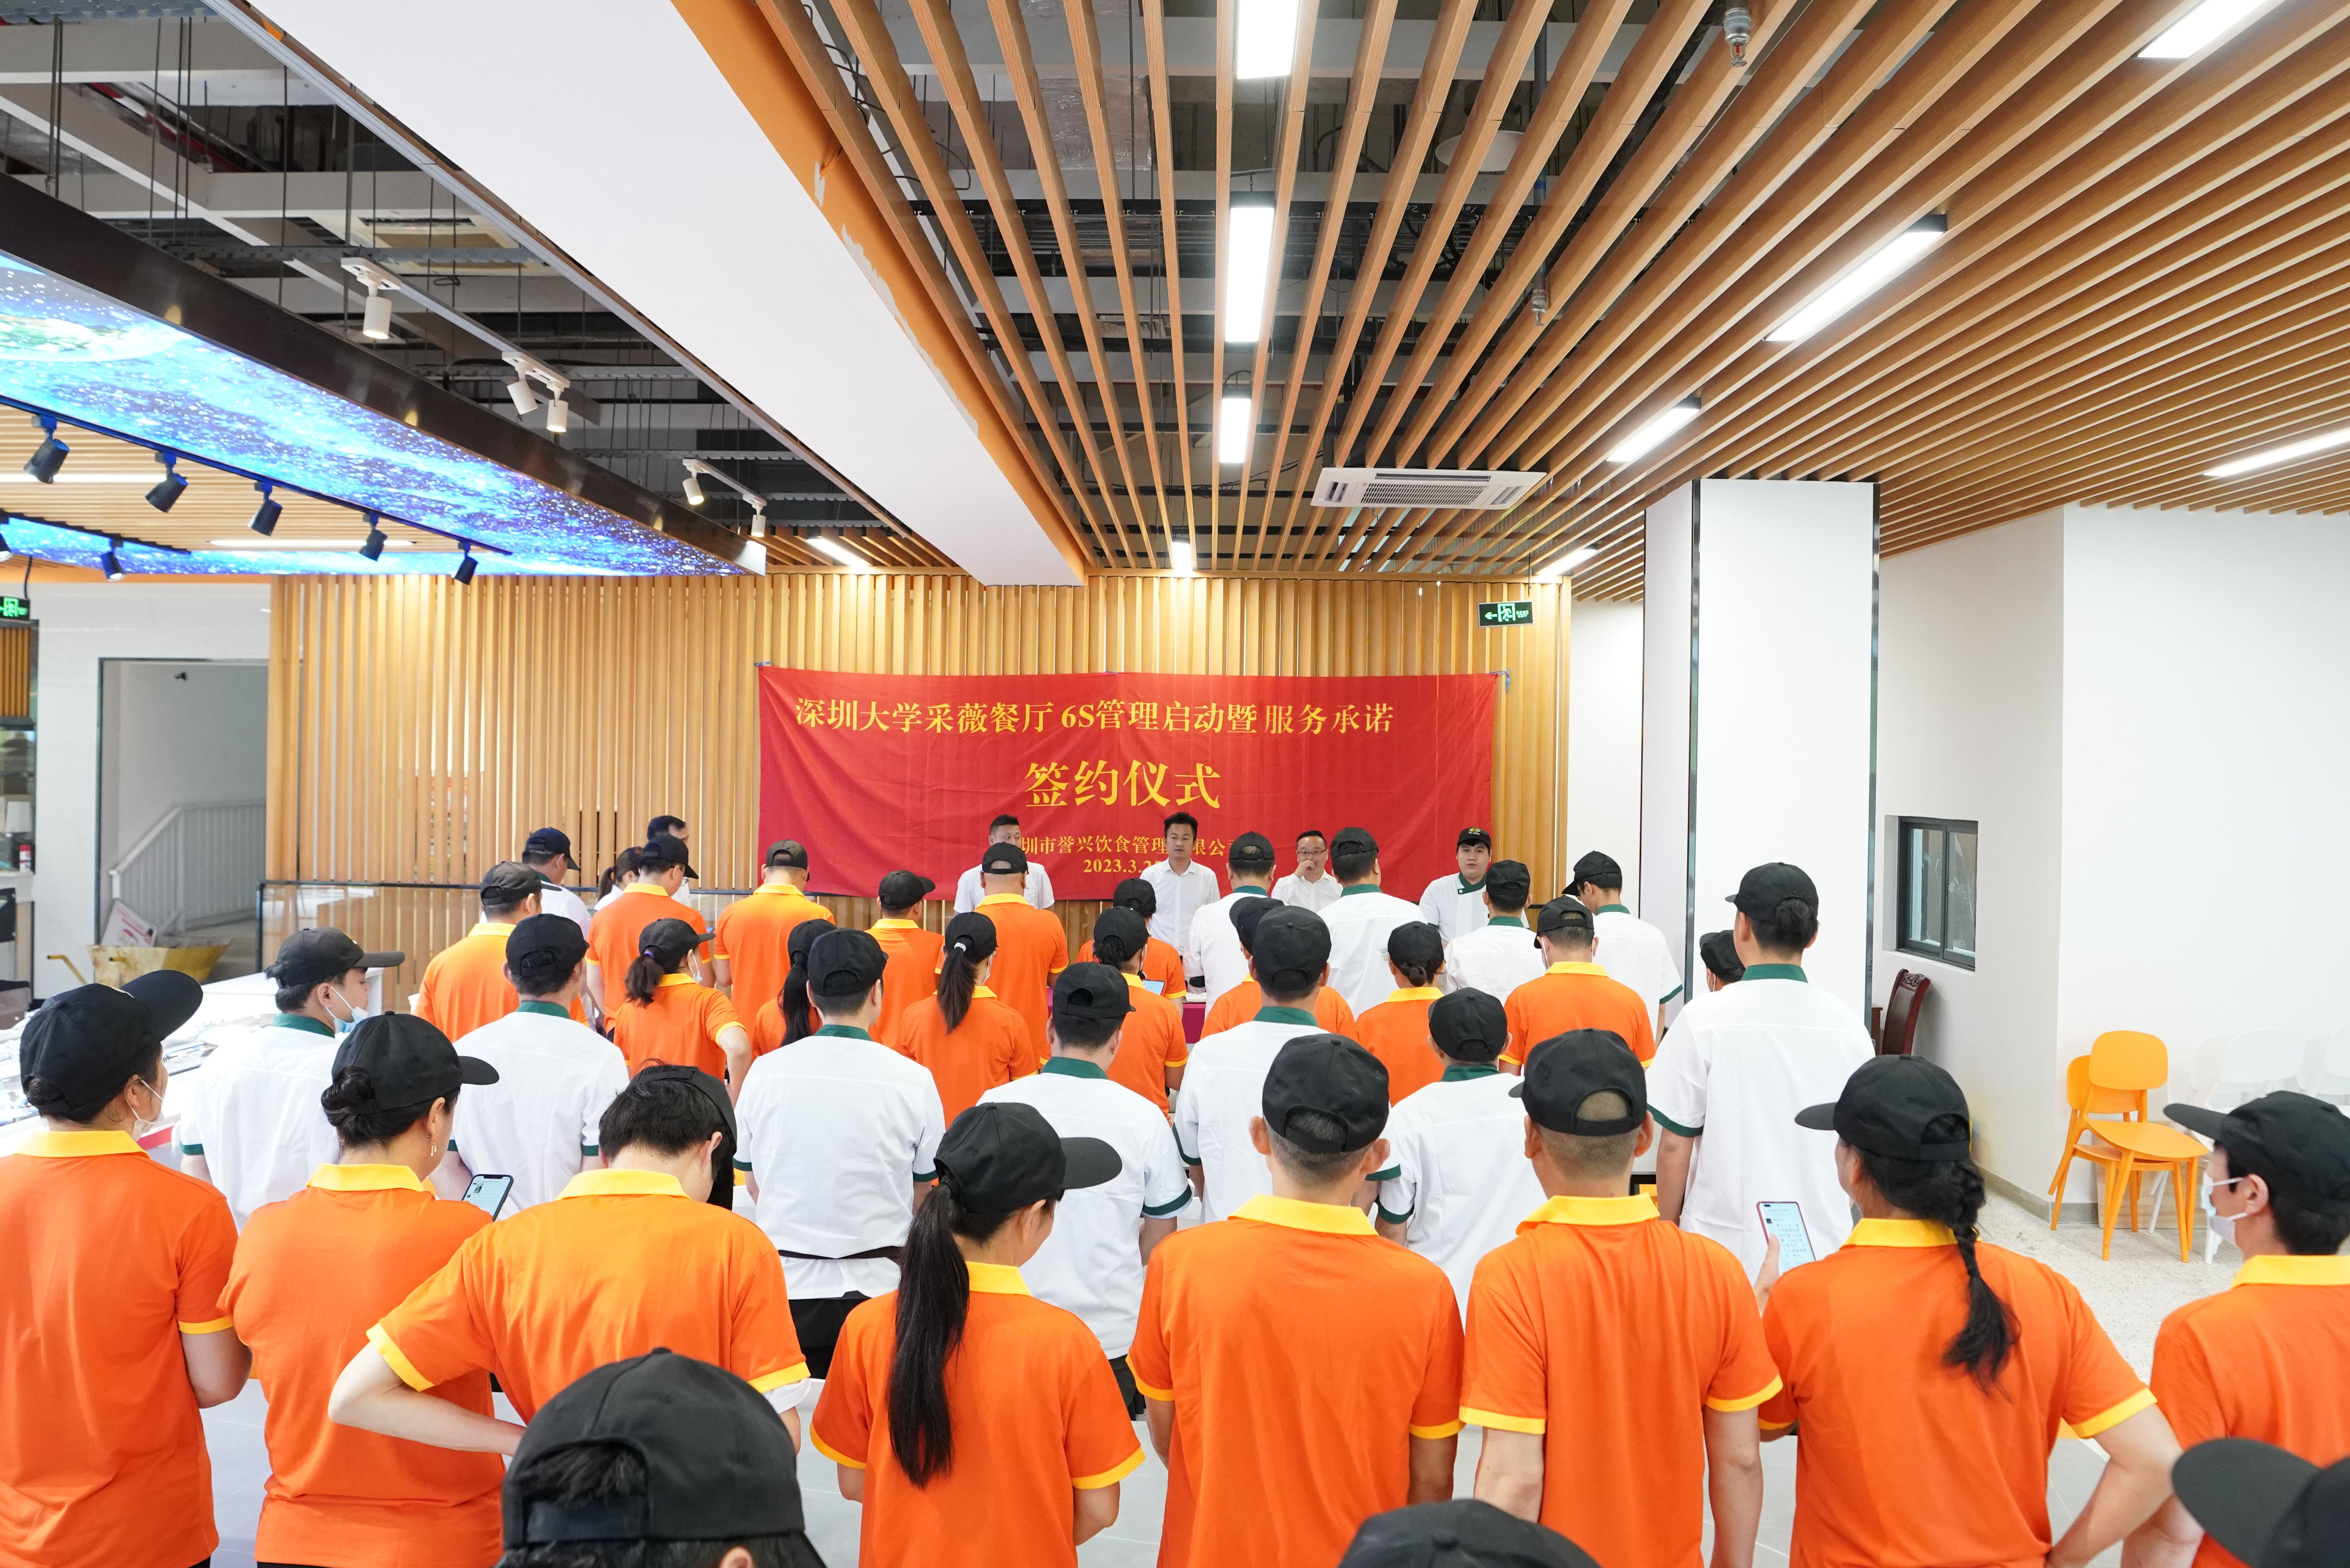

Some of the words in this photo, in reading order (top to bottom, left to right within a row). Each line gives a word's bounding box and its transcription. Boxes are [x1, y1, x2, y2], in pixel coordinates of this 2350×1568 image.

[1024, 759, 1221, 809] 签约仪式
[1083, 859, 1162, 873] 2023.3.
